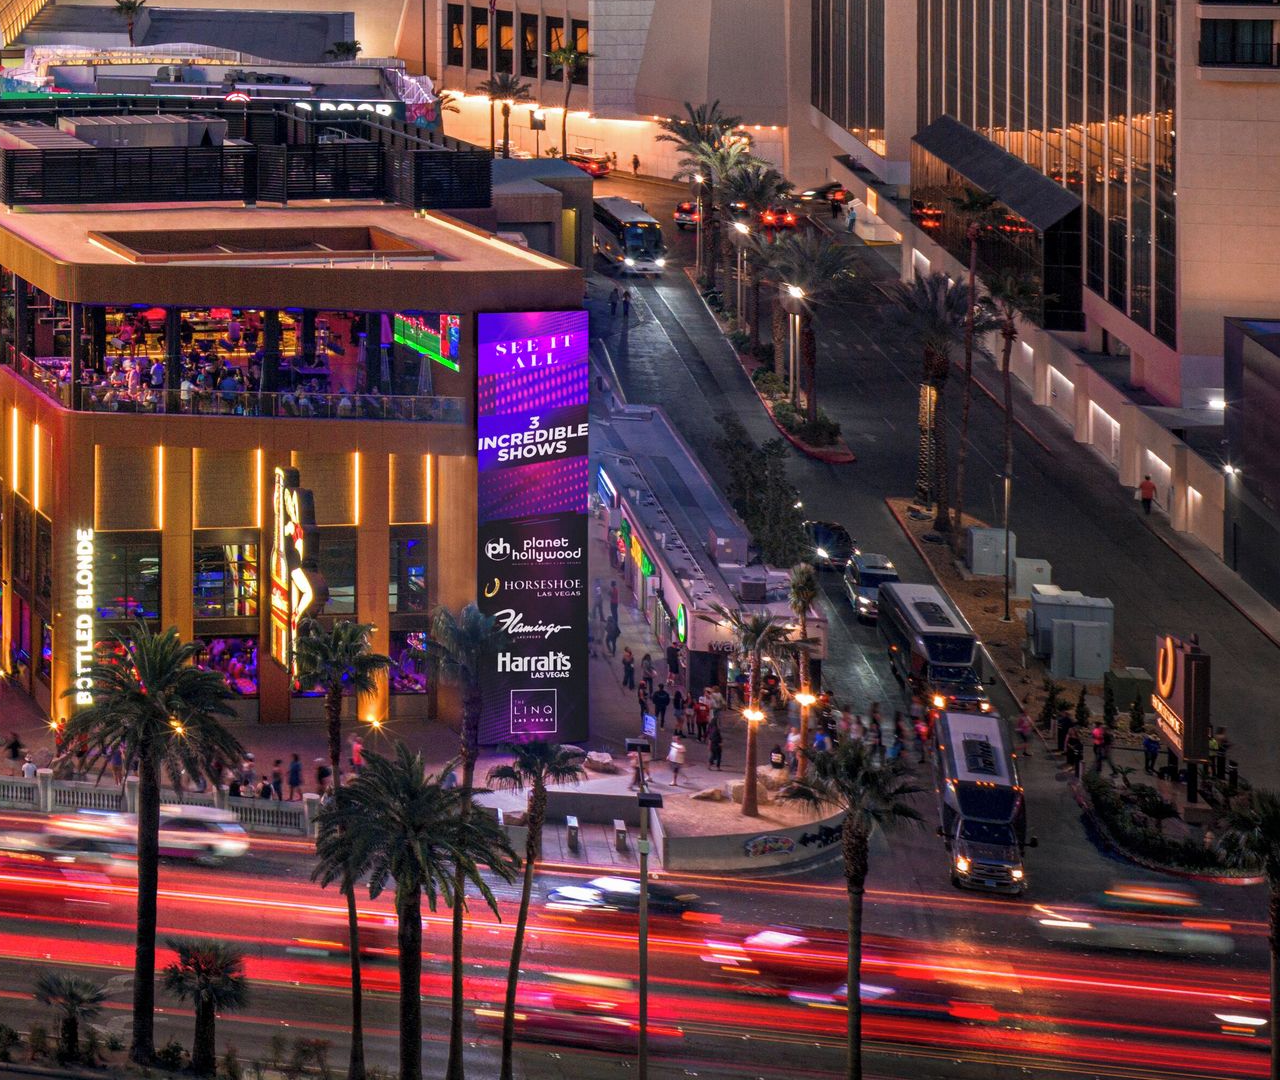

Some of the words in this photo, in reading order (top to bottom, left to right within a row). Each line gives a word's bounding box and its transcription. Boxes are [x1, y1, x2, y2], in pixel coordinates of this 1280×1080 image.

[496, 338, 539, 356] SEE
[550, 334, 574, 349] IT
[512, 352, 559, 369] ALL
[529, 416, 540, 429] 3
[478, 423, 589, 451] INCREDIBLE
[497, 440, 567, 462] SHOWS
[488, 538, 511, 558] ph
[524, 537, 569, 551] planet
[512, 547, 582, 562] hollywood
[76, 528, 93, 609] BLONDE
[504, 579, 581, 590] HORSESHOE
[494, 608, 572, 639] Flamingo
[76, 613, 93, 705] BOTTLED
[514, 705, 553, 715] LINQ
